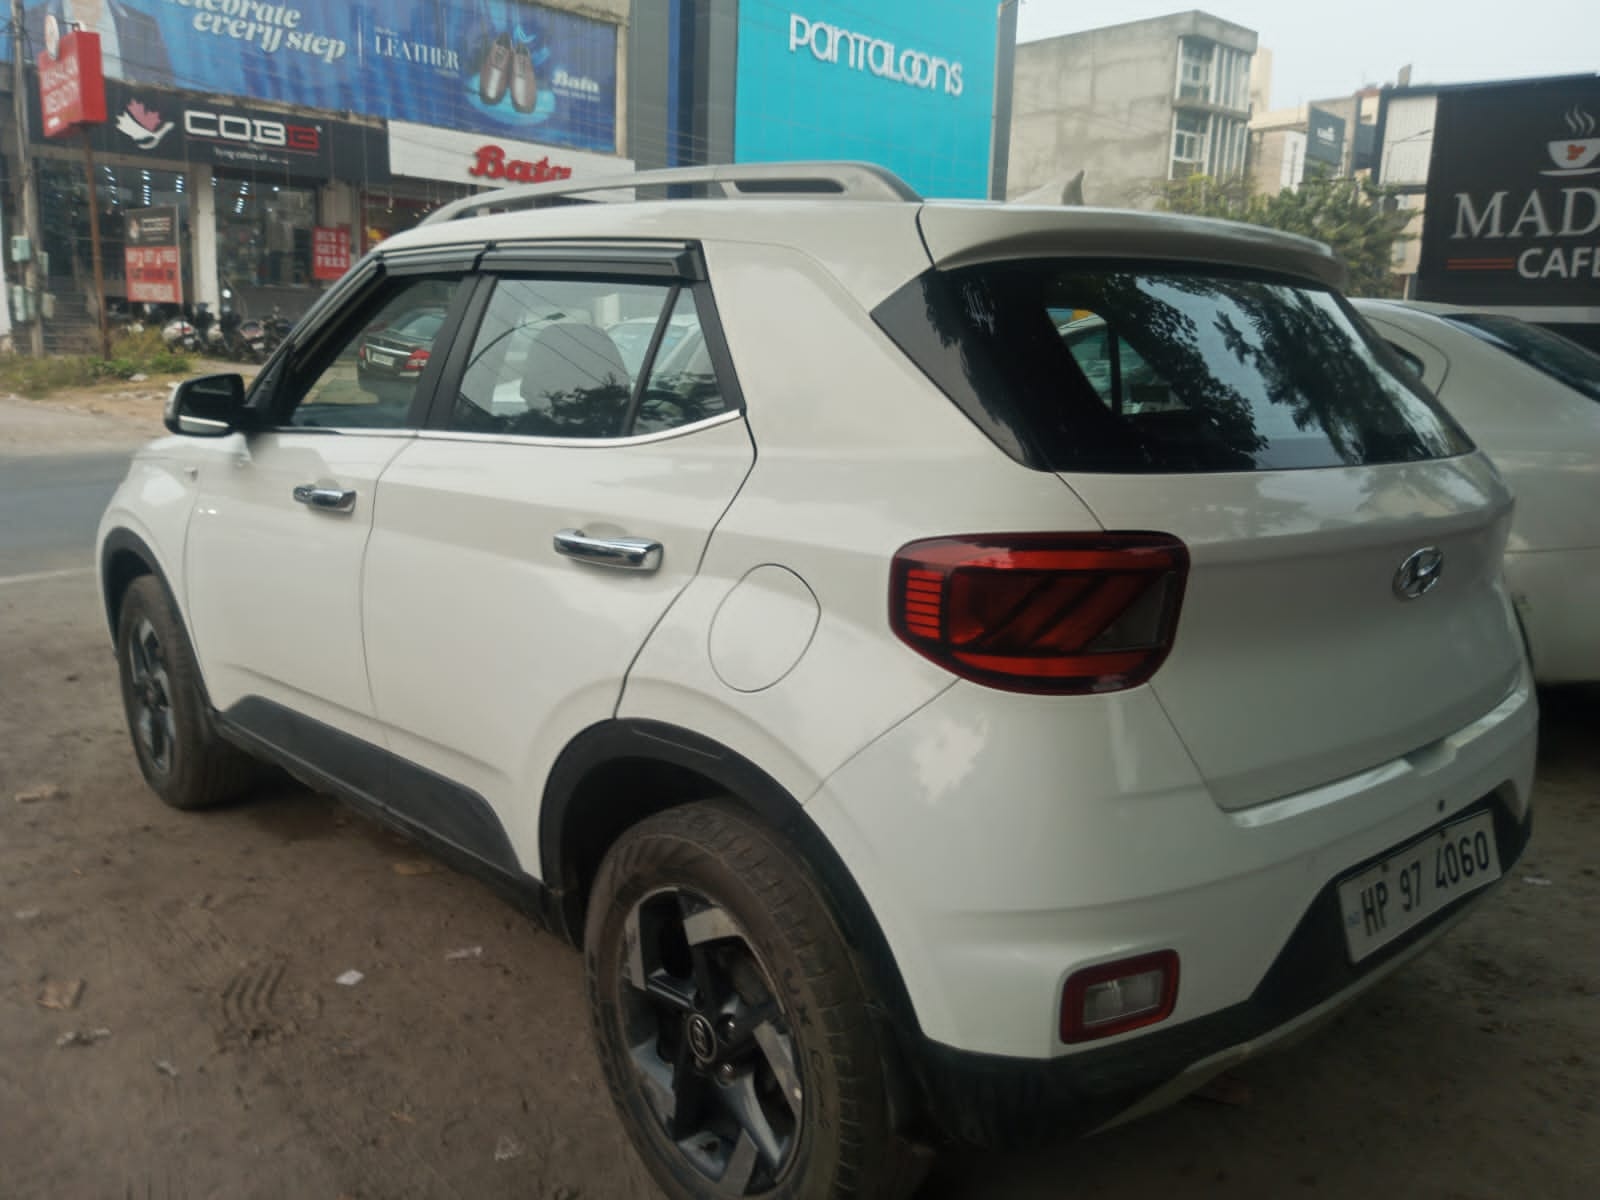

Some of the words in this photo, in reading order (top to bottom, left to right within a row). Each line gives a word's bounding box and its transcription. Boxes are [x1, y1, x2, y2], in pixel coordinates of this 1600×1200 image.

[193, 11, 282, 52] every
[286, 31, 346, 64] step
[375, 34, 459, 71] LEATHER
[184, 110, 319, 150] COBB
[1360, 881, 1389, 937] HP
[1400, 860, 1422, 912] 97
[1434, 830, 1490, 889] 4060
